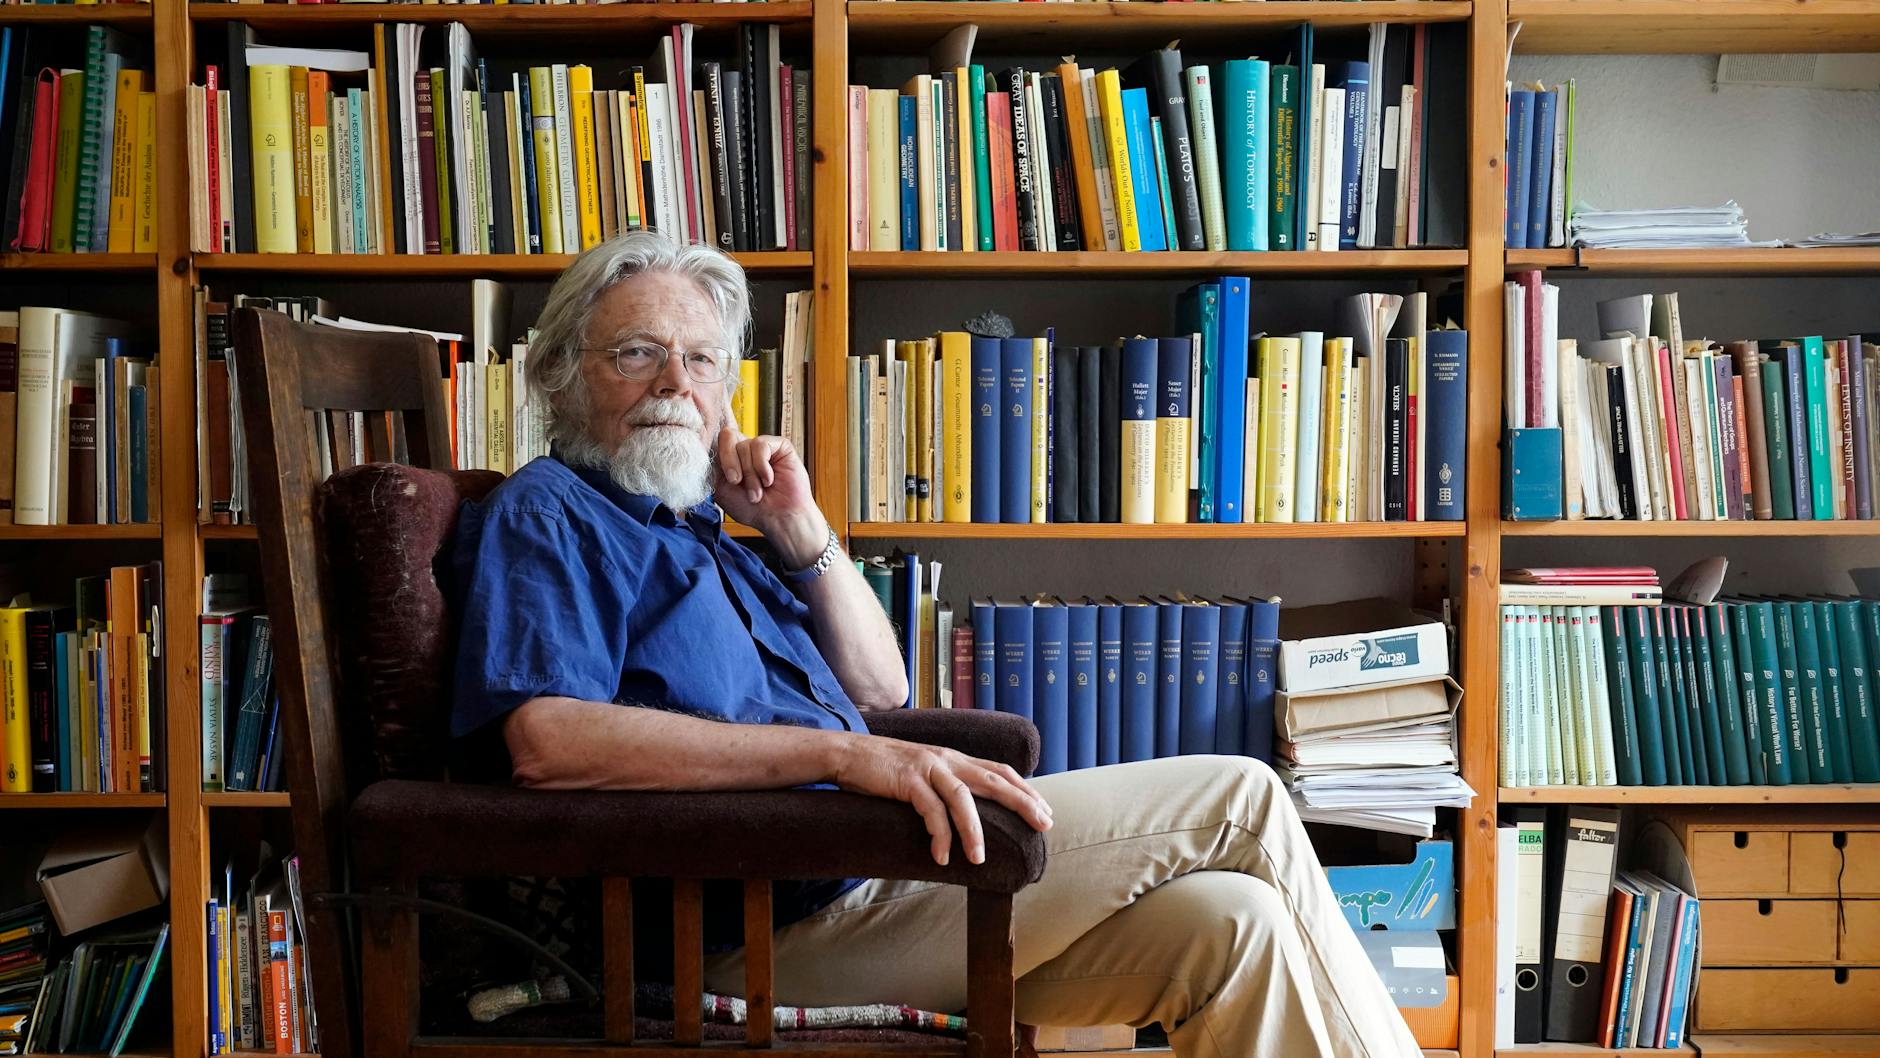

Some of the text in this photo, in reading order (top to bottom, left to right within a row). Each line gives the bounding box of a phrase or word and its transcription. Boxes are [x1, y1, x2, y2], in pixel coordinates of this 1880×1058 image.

[1011, 74, 1030, 192] GRAY IDEAS OF SPACE
[1284, 116, 1293, 140] History
[1246, 90, 1256, 210] HISTORY of TOPOLOGY
[1285, 141, 1292, 150] of
[559, 116, 572, 216] GEOMETRY CIVILIZED
[1118, 149, 1127, 174] Worlds
[1178, 136, 1194, 182] PLATO'S
[1124, 190, 1130, 198] of
[1126, 200, 1134, 228] Nothing
[1792, 372, 1801, 402] Philosophy
[1842, 384, 1852, 420] LEVELS
[1844, 422, 1852, 434] OF
[1844, 435, 1855, 482] INFINITY
[204, 644, 214, 680] MIND
[1310, 648, 1349, 668] speed
[1378, 652, 1406, 664] tecno
[1767, 688, 1776, 708] History
[1789, 696, 1798, 714] Better
[209, 698, 218, 761] SYLVIA NASAR
[1771, 715, 1779, 734] Virtual
[1793, 730, 1802, 750] Worse?
[1518, 834, 1542, 844] ELBA
[260, 900, 270, 964] SAN FRANCISCO
[240, 936, 251, 999] Rügen Hiddensee
[1628, 948, 1636, 964] Segler
[280, 1002, 288, 1039] BOSTON
